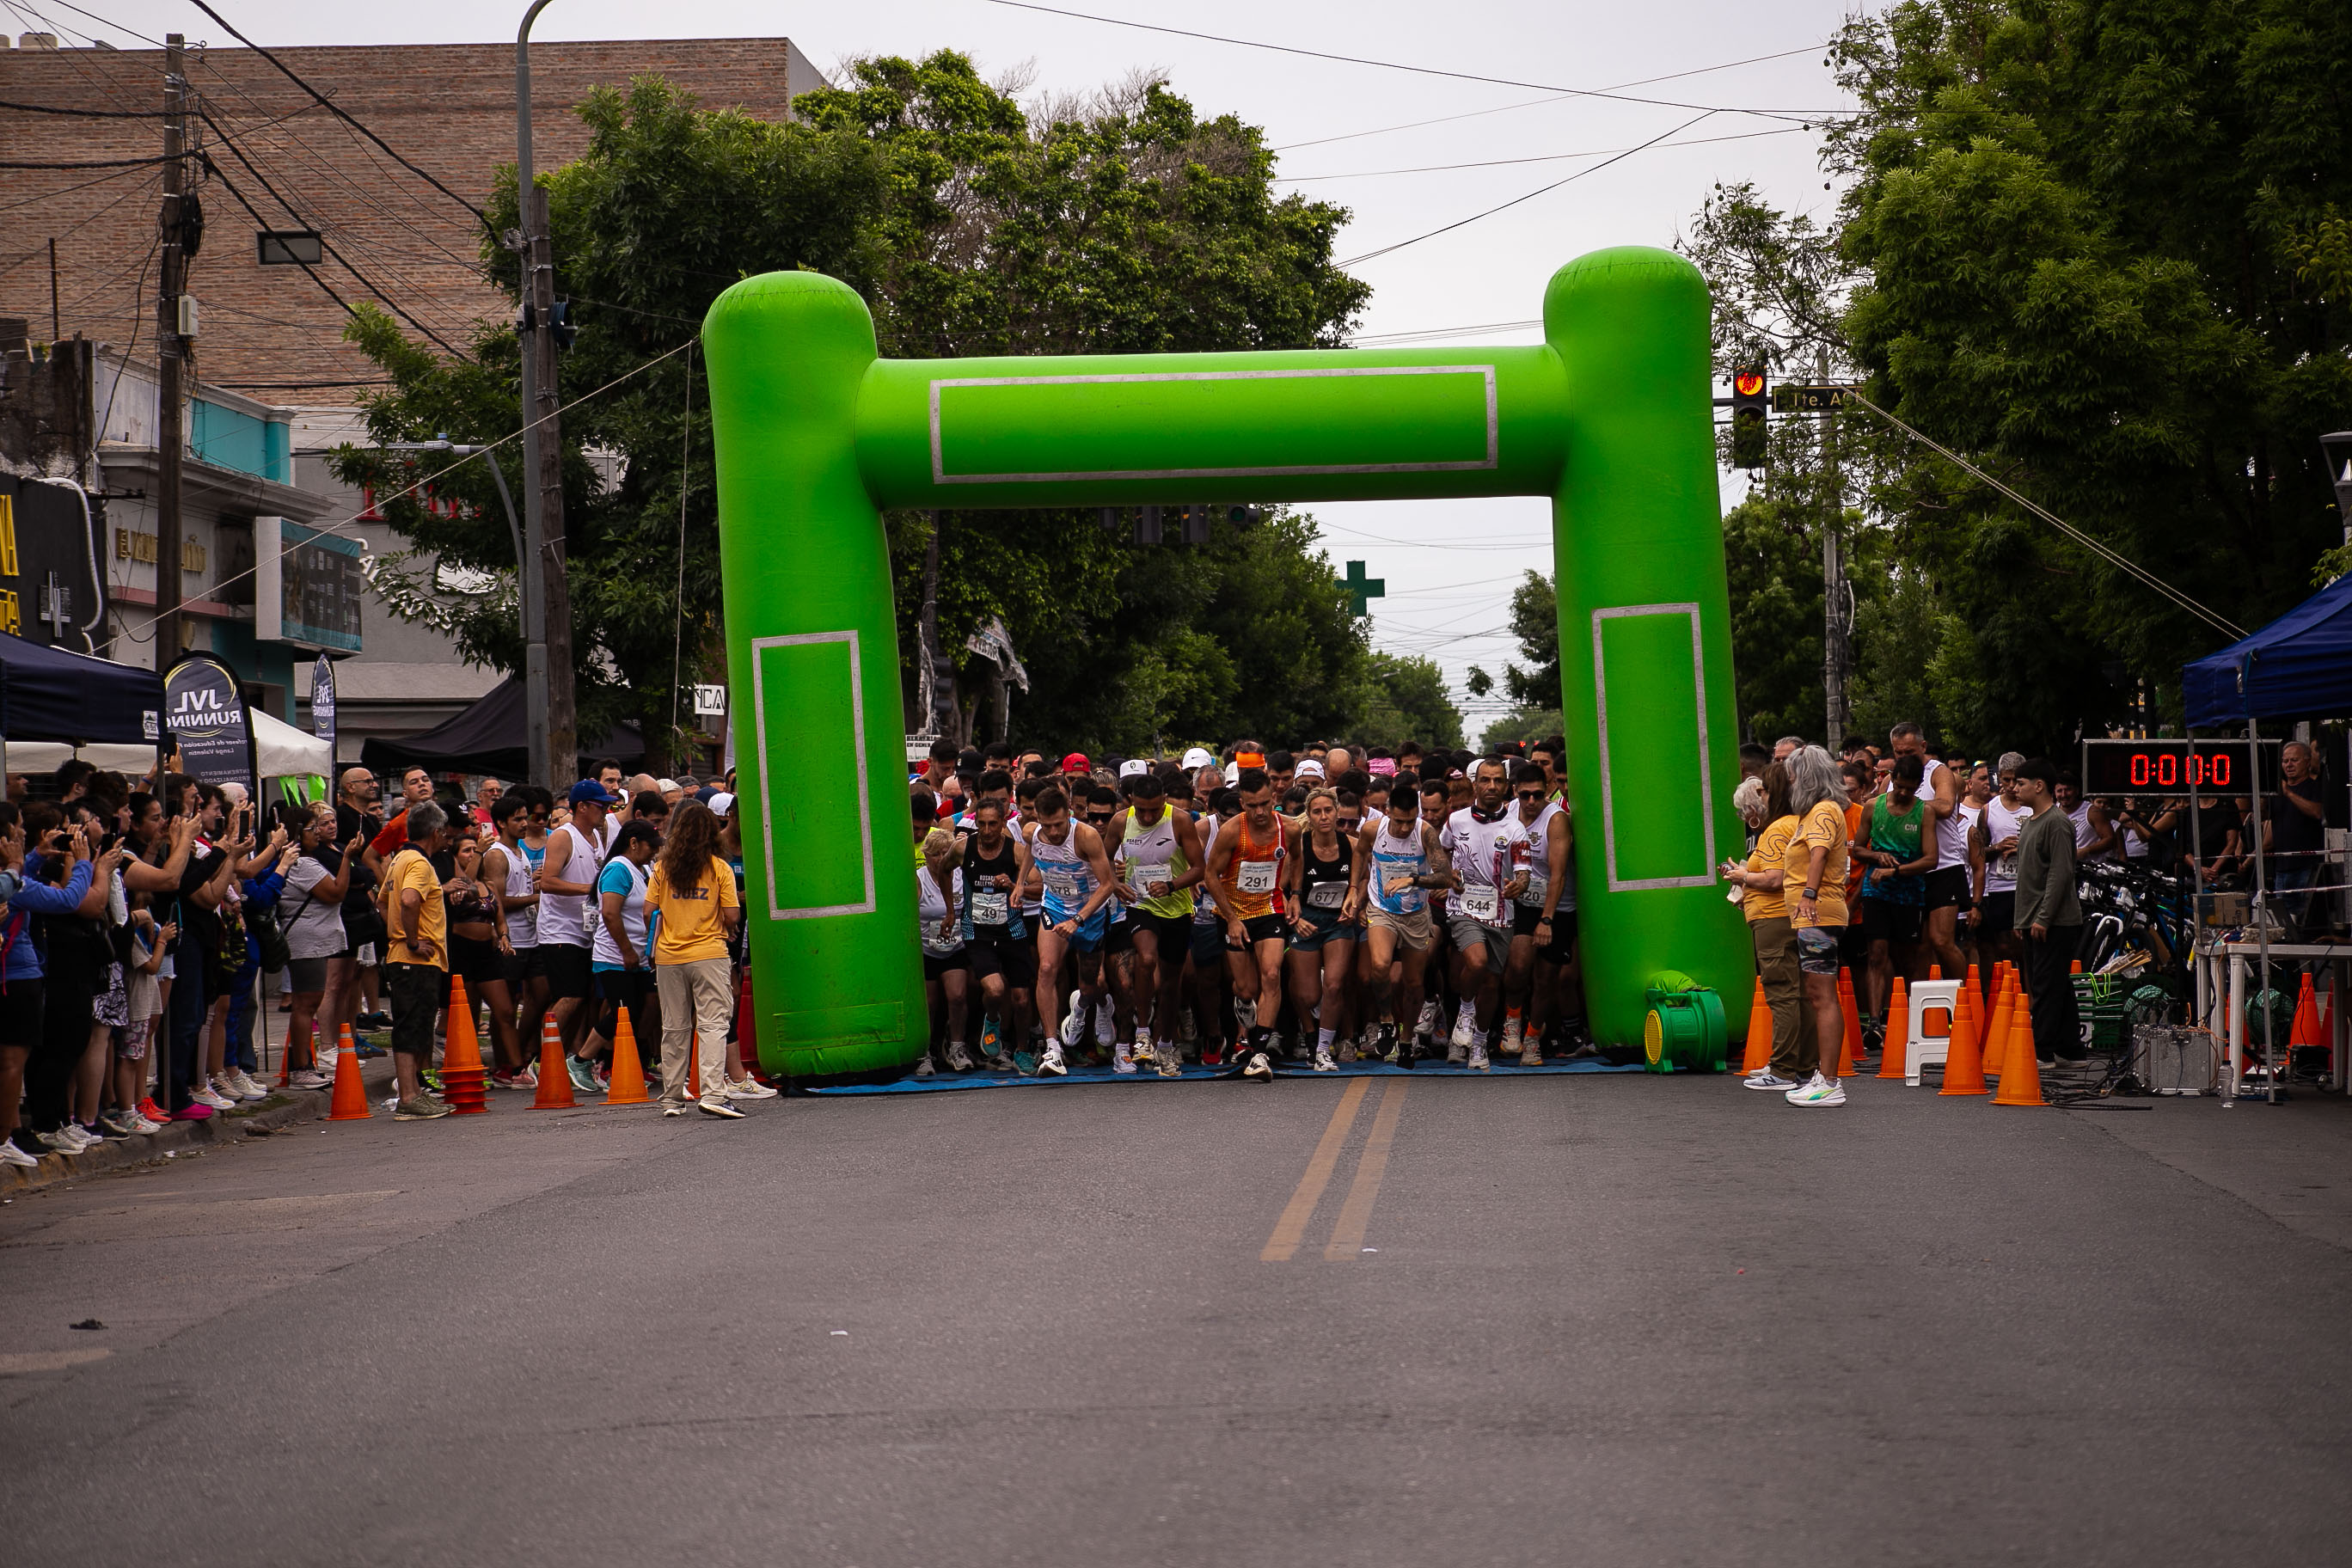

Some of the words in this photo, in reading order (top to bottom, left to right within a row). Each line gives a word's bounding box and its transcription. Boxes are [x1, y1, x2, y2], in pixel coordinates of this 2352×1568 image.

[1904, 824, 1918, 832] CM
[1244, 876, 1268, 888] 291
[1314, 891, 1338, 903] 677
[1466, 899, 1491, 912] 644
[982, 908, 997, 920] 49
